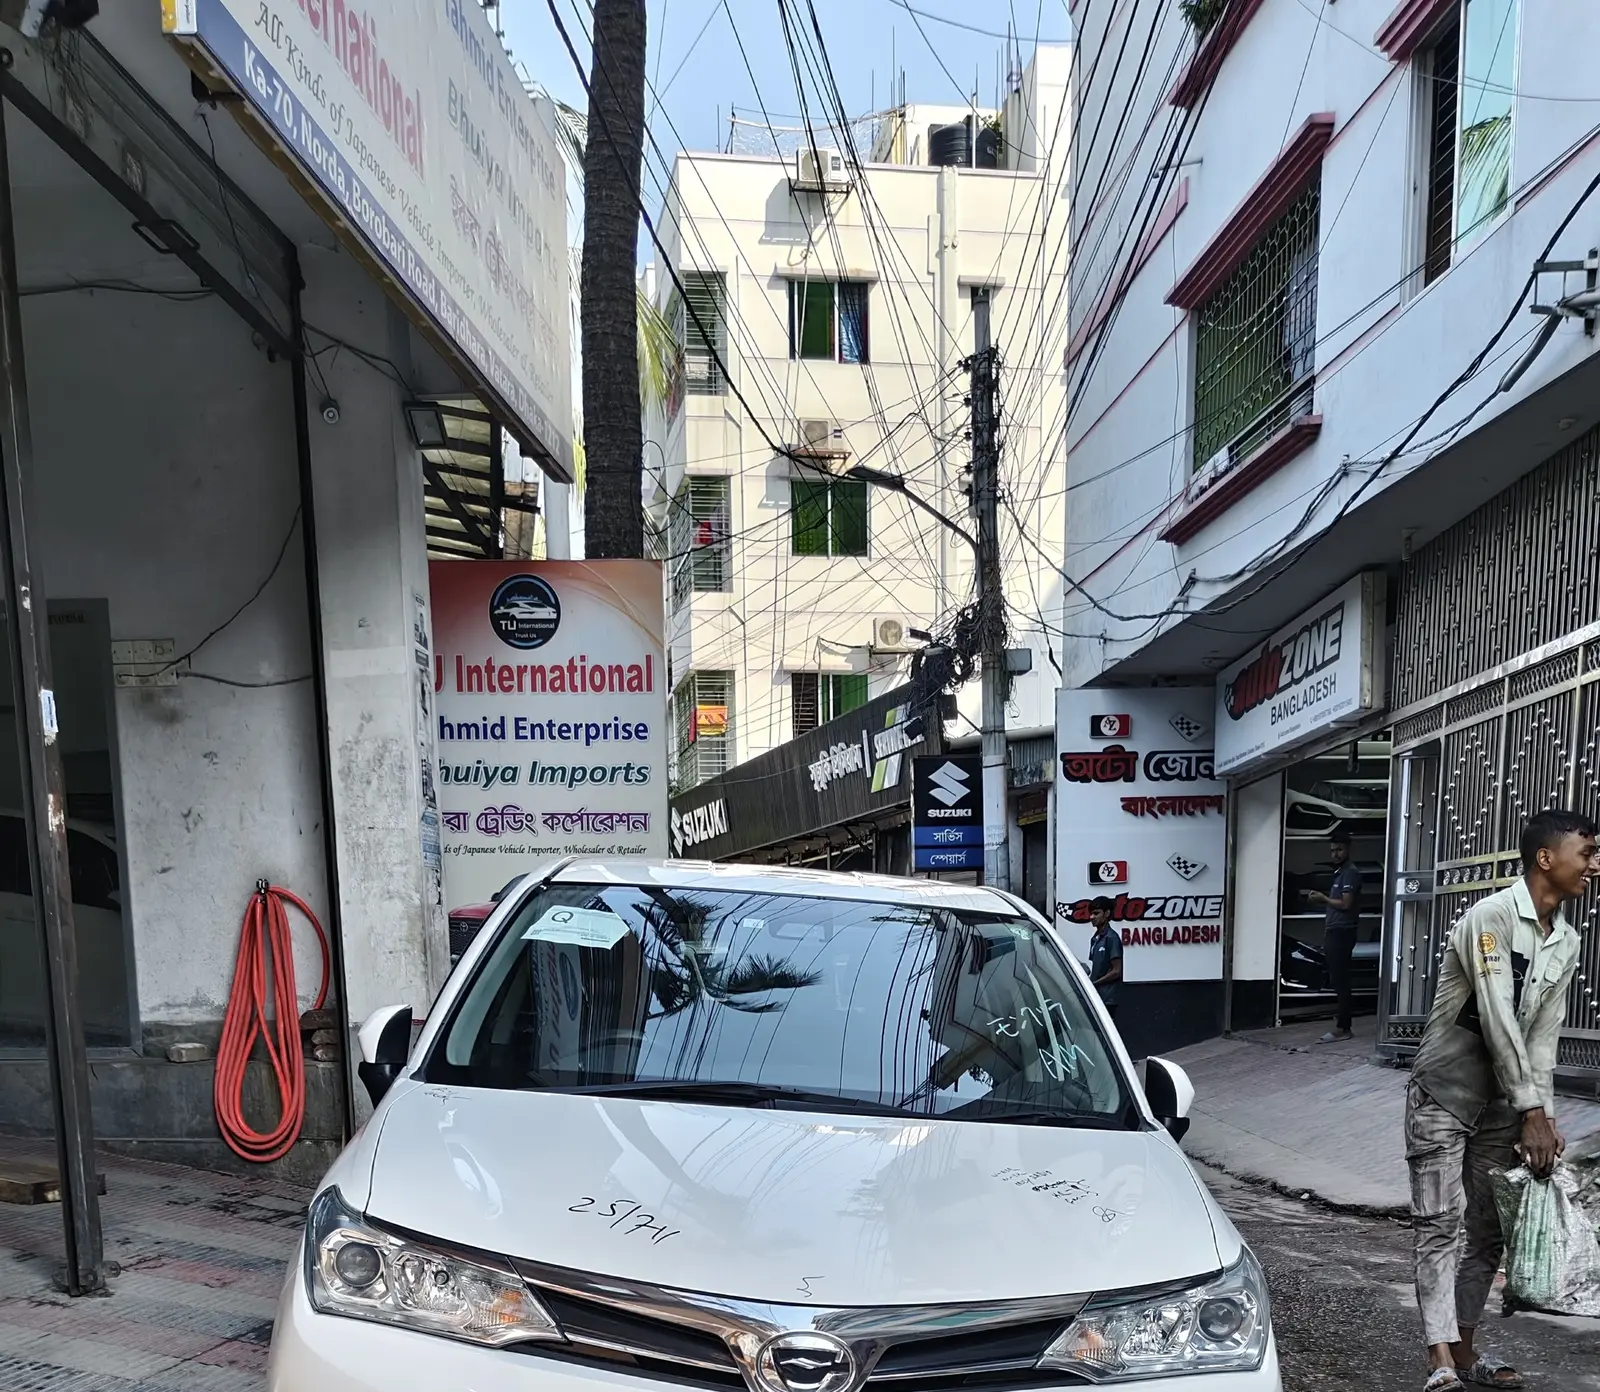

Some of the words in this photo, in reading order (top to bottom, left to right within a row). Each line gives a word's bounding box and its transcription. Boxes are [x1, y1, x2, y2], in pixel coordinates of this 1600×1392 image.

[254, 2, 284, 49] All
[284, 35, 327, 109] Kinds
[330, 104, 346, 135] of
[345, 119, 396, 201] Japanese
[399, 188, 434, 252] Vehicle
[243, 41, 298, 140] Ka-70,
[301, 113, 349, 205] Norda,
[408, 249, 438, 313] Road,
[500, 620, 517, 631] TU
[456, 654, 653, 694] International
[1270, 672, 1337, 726] BANGLADESH
[439, 715, 506, 741] hmid
[513, 716, 649, 747] Enterprise
[438, 759, 518, 790] huiya
[528, 759, 650, 788] Imports
[1063, 746, 1138, 781] অটো
[476, 804, 537, 836] ট্রেডিং
[541, 806, 650, 833] কর্পোরেশন
[682, 798, 730, 847] SUZUKI
[927, 808, 972, 818] SUZUKI
[1120, 796, 1224, 819] বাংলাদেশ
[453, 844, 463, 856] of
[462, 844, 497, 856] Japanese
[498, 844, 525, 855] Vehicle
[528, 845, 562, 856] Importer,
[564, 845, 605, 855] Wholesaler
[606, 845, 616, 855] &
[617, 845, 647, 856] Retailer
[933, 828, 963, 843] সার্ভিস
[551, 910, 574, 924] Q
[1073, 893, 1224, 921] atoZONE
[1121, 925, 1221, 946] BANGLADESH
